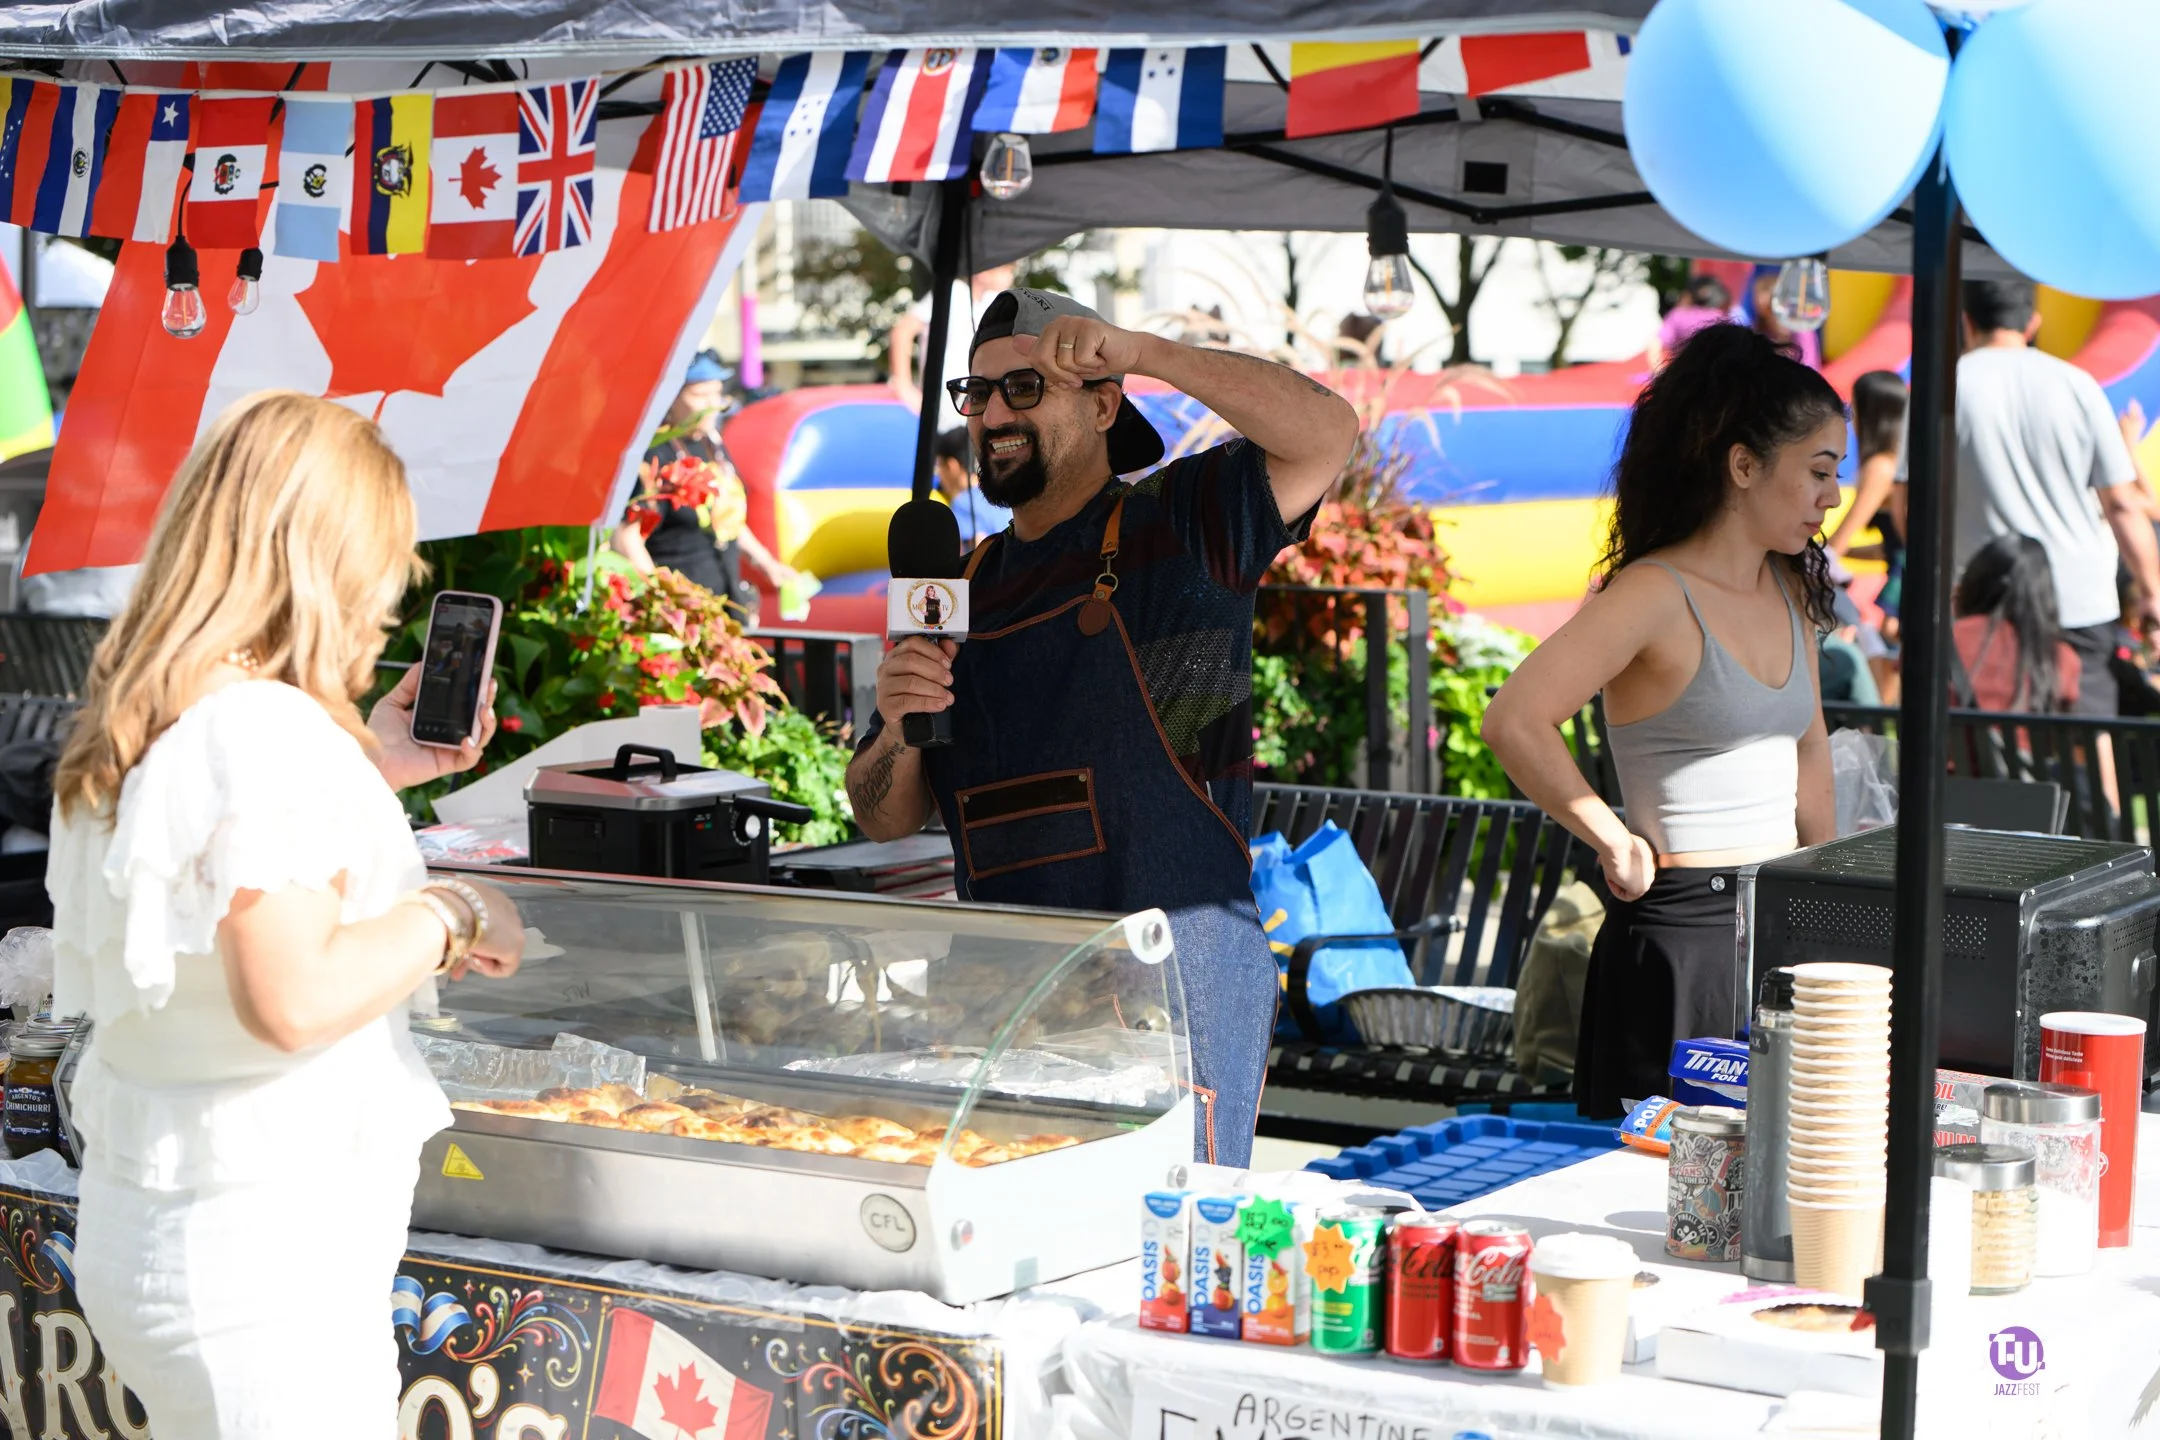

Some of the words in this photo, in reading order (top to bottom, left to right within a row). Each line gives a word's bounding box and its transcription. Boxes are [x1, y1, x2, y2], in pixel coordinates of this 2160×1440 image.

[1684, 1049, 1748, 1076] TITAN
[1711, 1073, 1739, 1083] FOIL
[5, 1099, 51, 1113] CHIMICHURRI
[11, 1093, 41, 1102] ARGENTO'S
[1633, 1096, 1670, 1129] POLY
[1680, 1164, 1703, 1177] VANS
[870, 1212, 906, 1232] CFL
[1142, 1240, 1158, 1301] OASIS
[1193, 1246, 1210, 1308] OASIS
[1464, 1244, 1529, 1287] Cola
[1247, 1253, 1264, 1315] OASIS
[1232, 1392, 1431, 1440] ARGENTINE
